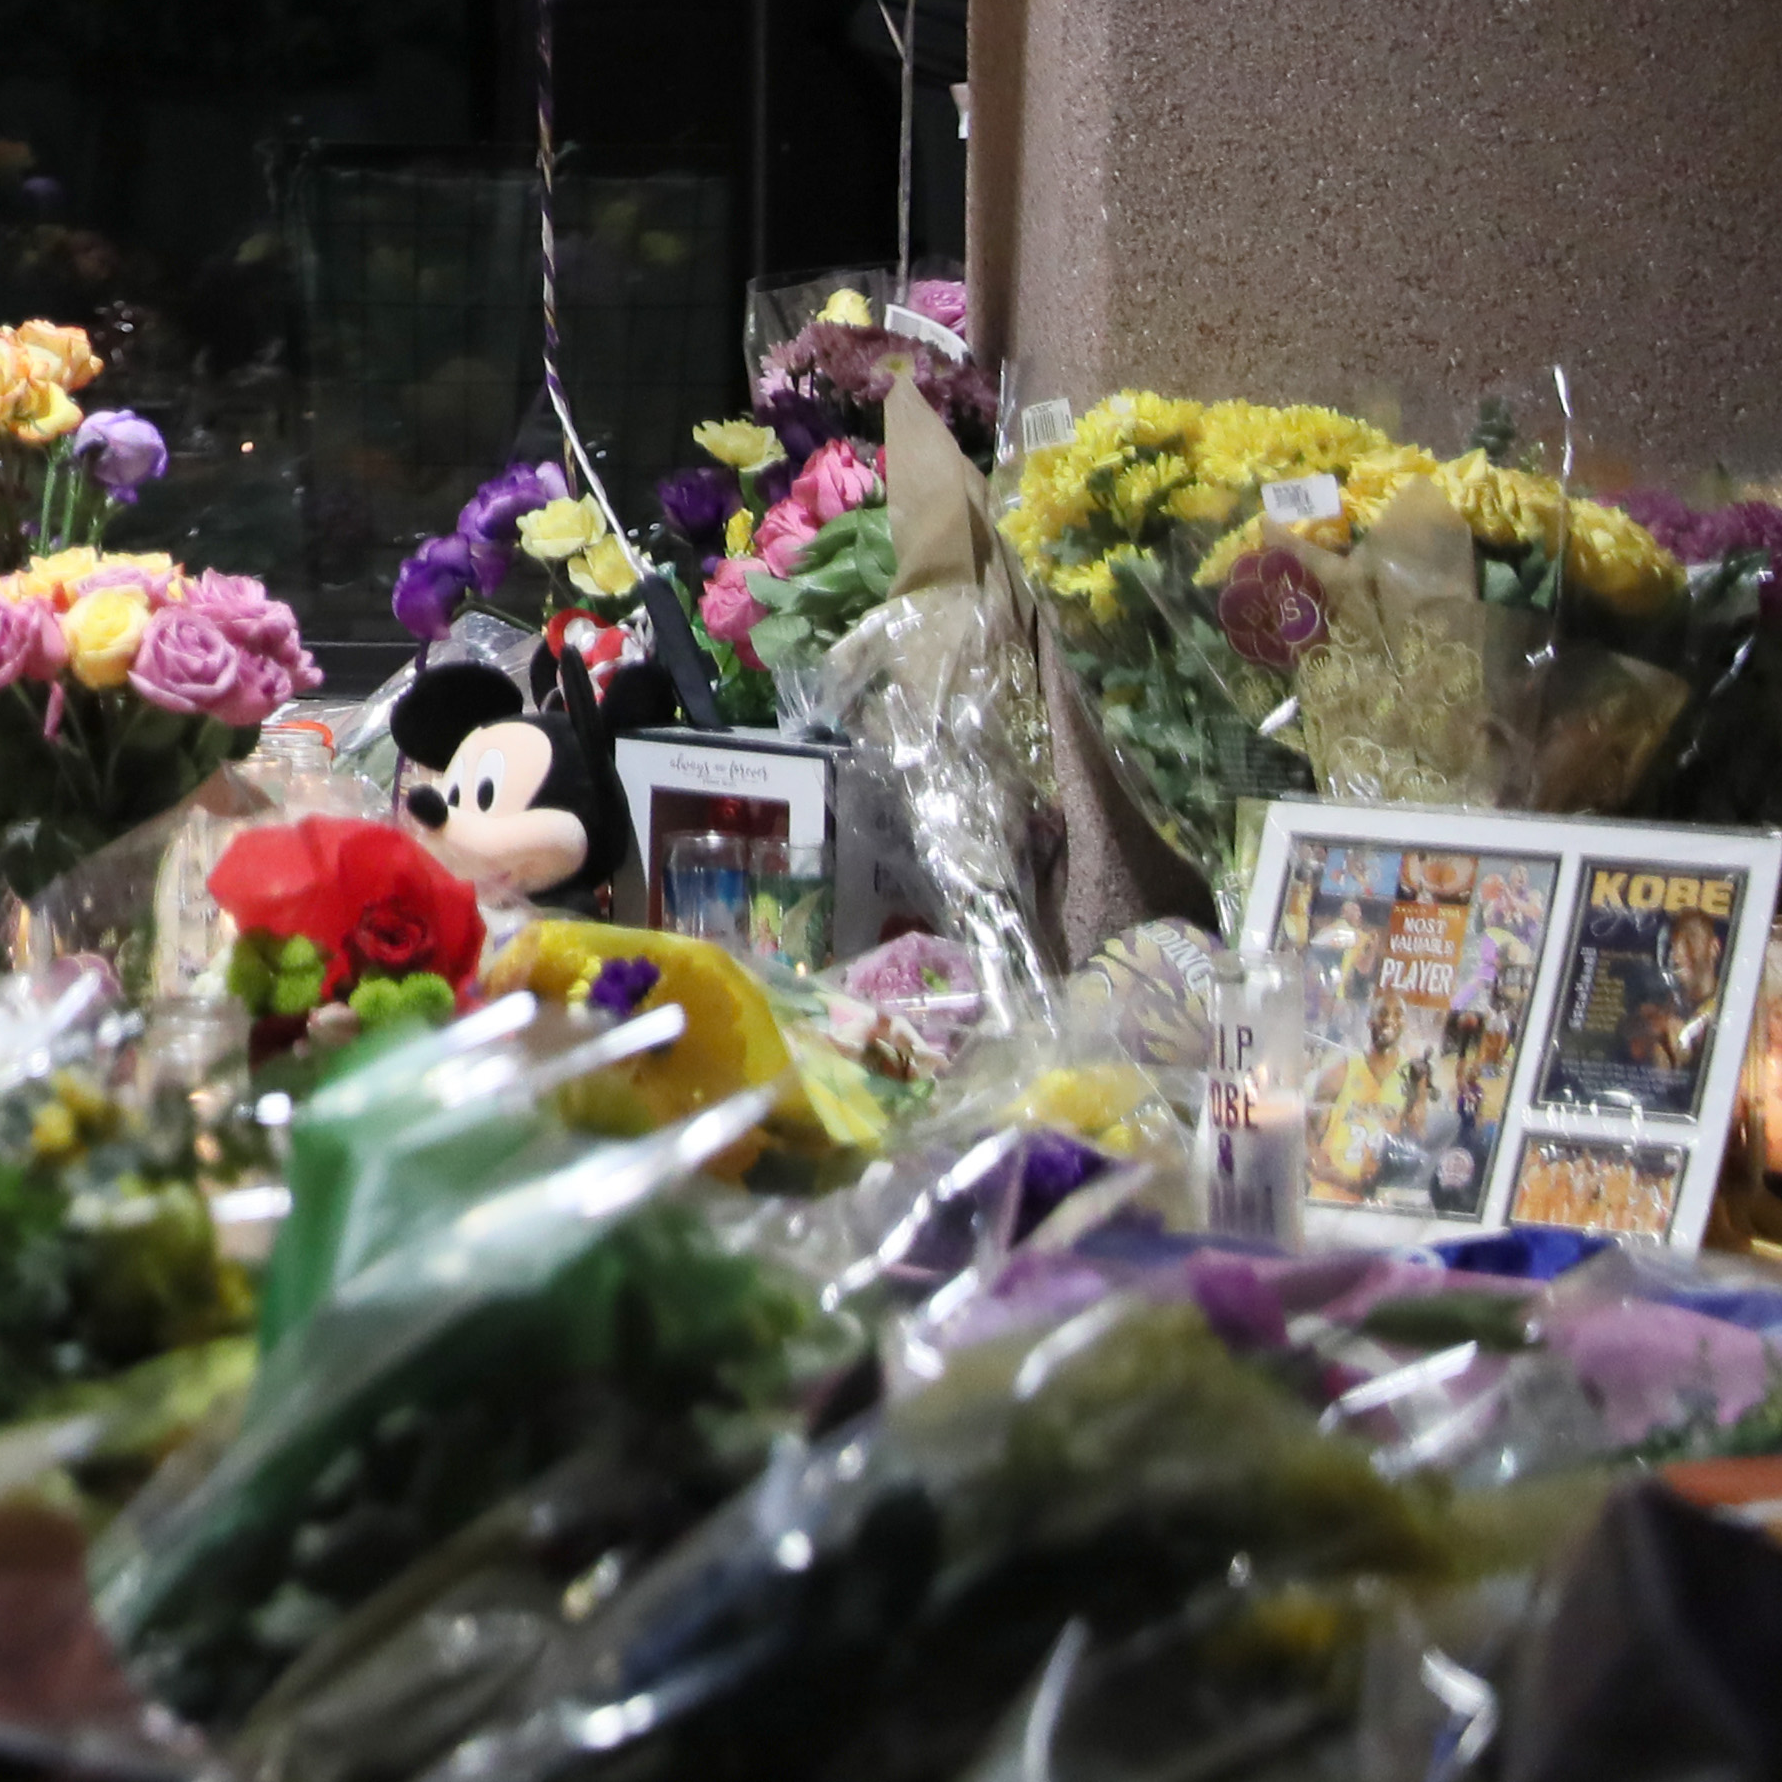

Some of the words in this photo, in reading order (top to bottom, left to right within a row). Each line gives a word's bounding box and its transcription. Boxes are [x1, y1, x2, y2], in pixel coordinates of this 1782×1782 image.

[1590, 871, 1734, 916] KOBE
[1403, 917, 1448, 935] MOST
[1154, 929, 1215, 994] DING
[1379, 956, 1454, 995] PLAYER
[1209, 1078, 1259, 1130] OBE
